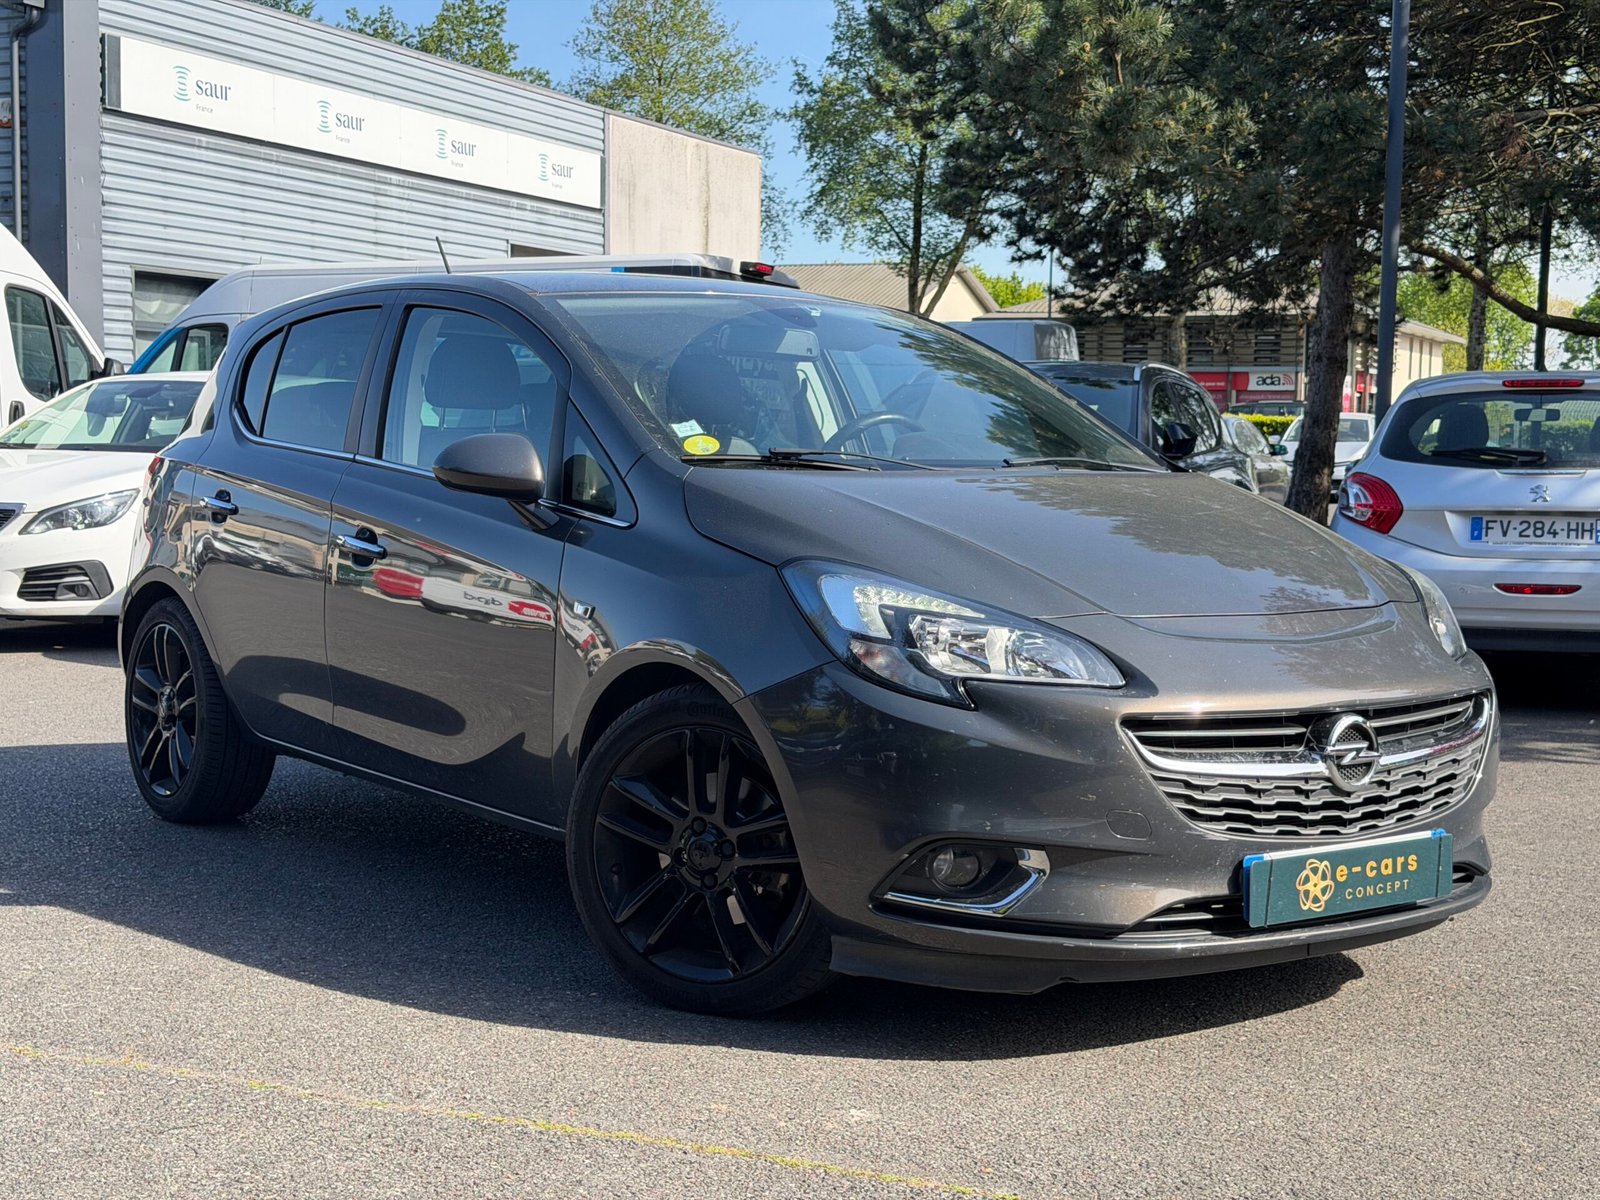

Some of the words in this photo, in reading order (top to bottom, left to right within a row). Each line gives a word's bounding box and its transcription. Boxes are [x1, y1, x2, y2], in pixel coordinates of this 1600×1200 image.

[195, 79, 232, 101] saur
[196, 103, 214, 112] France
[335, 112, 365, 132] saur
[451, 140, 477, 157] saur
[551, 163, 574, 178] saur
[1256, 373, 1281, 387] ada
[1485, 520, 1594, 540] FV-284-HH
[1336, 854, 1417, 881] e-cars
[1345, 879, 1408, 899] CONCEPT
